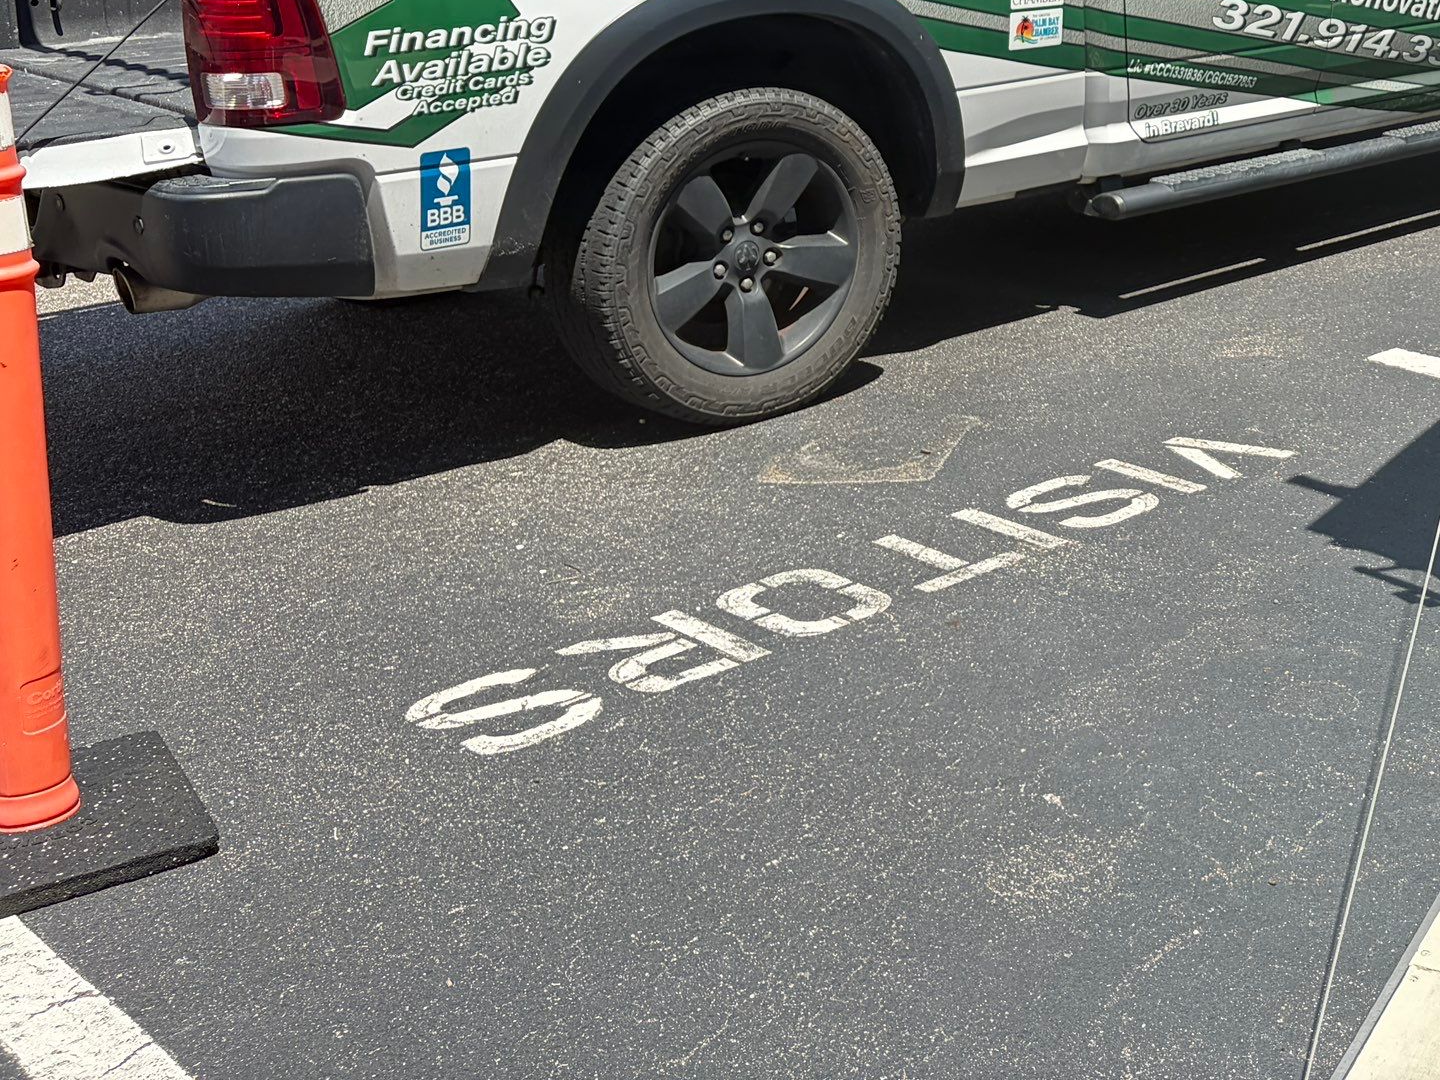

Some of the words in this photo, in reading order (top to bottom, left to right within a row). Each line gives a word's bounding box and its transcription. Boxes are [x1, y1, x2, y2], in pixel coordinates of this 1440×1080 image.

[363, 15, 555, 57] Financing
[1032, 18, 1047, 27] PALM
[1048, 16, 1060, 26] BAY
[371, 42, 552, 87] Available
[396, 76, 467, 101] Credit
[468, 70, 533, 91] Cards
[411, 87, 519, 116] Accepted
[1134, 101, 1170, 120] Over
[1170, 97, 1190, 113] 30
[1190, 91, 1229, 110] Years
[1145, 121, 1159, 138] in
[1159, 110, 1219, 135] Brevard!
[427, 204, 465, 228] BBB
[424, 227, 467, 240] ACCREDITED
[429, 234, 462, 246] BUSINESS
[405, 436, 1298, 755] VISITORS
